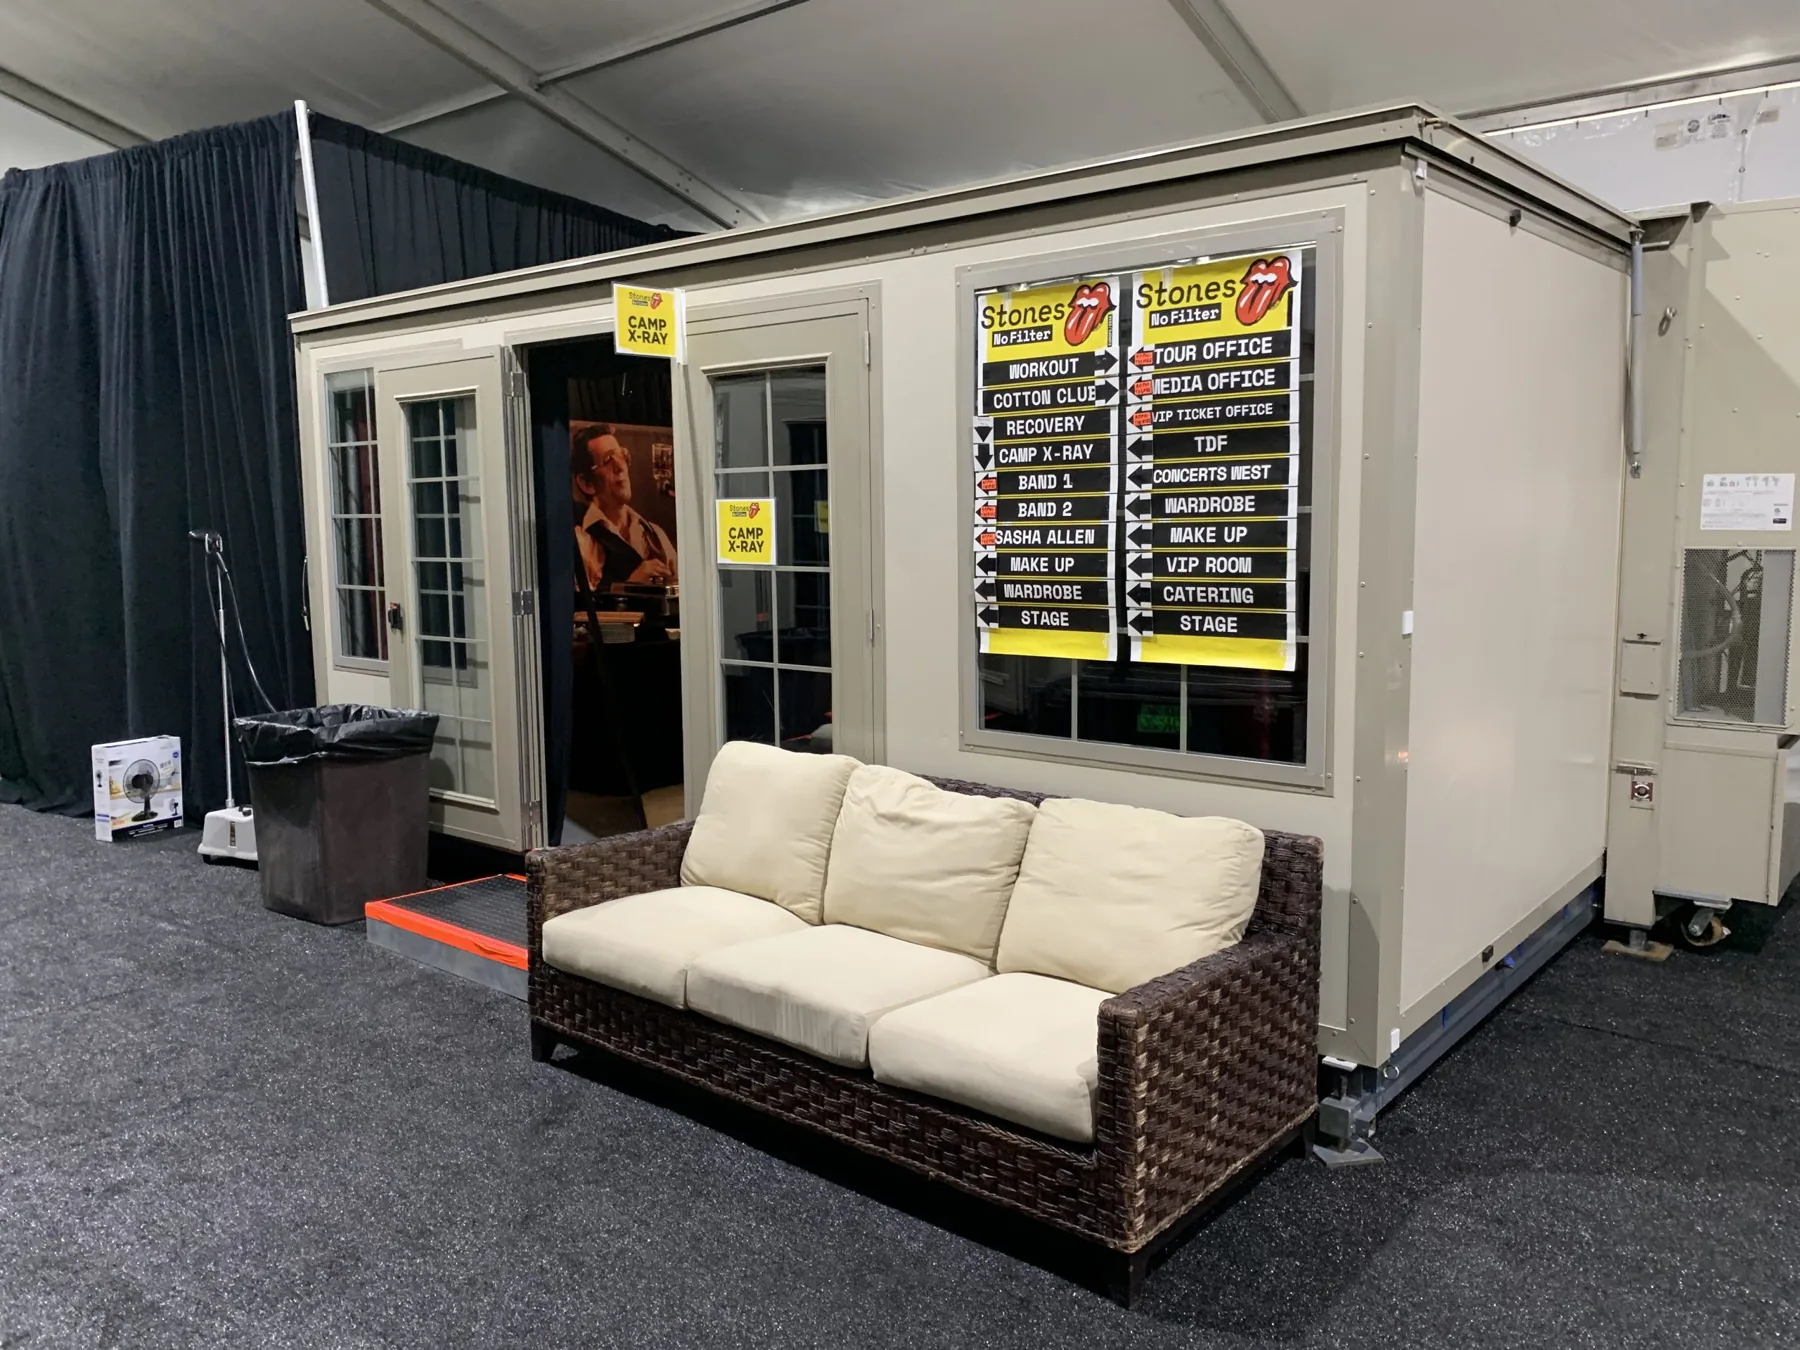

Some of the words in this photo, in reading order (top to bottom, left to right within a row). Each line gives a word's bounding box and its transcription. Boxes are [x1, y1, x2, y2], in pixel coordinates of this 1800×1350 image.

[1136, 279, 1236, 309] Stones
[628, 315, 667, 331] CAMP
[981, 303, 1065, 329] Stones
[1151, 314, 1169, 326] No
[1171, 308, 1219, 324] Filter
[628, 329, 668, 345] X-RAY
[993, 333, 1008, 346] No
[1010, 330, 1051, 344] Filter
[1154, 345, 1197, 365] TOUR
[1202, 336, 1273, 360] OFFICE
[1009, 358, 1079, 380] WORKOUT
[1207, 369, 1275, 390] OFFICE
[993, 389, 1051, 409] COTTON
[1057, 386, 1096, 404] CLUB
[1152, 410, 1173, 422] VIP
[1177, 406, 1222, 421] TICKET
[1225, 403, 1273, 418] OFFICE
[1006, 416, 1085, 436] RECOVERY
[1194, 435, 1228, 452] TDF
[999, 447, 1037, 463] CAMP
[1043, 444, 1094, 461] X-RAY
[1018, 474, 1057, 490] BAND
[1063, 473, 1073, 489] 1
[1153, 466, 1227, 483] CONCERTS
[1231, 465, 1271, 481] WEST
[1018, 502, 1056, 518] BAND
[1062, 502, 1072, 517] 2
[1165, 496, 1255, 514] WARDROBE
[728, 527, 764, 539] CAMP
[995, 529, 1046, 545] SASHA
[1046, 529, 1095, 545] ALLEN
[1170, 527, 1216, 543] MAKE
[1223, 526, 1247, 543] UP
[728, 540, 765, 552] X-RAY
[1010, 557, 1049, 572] MAKE
[1055, 557, 1075, 572] UP
[1166, 557, 1198, 573] VIP
[1205, 557, 1252, 573] ROOM
[1003, 584, 1083, 600] WARDROBE
[1163, 586, 1254, 604] CATERING
[1021, 610, 1069, 627] STAGE
[1180, 616, 1237, 633] STAGE
